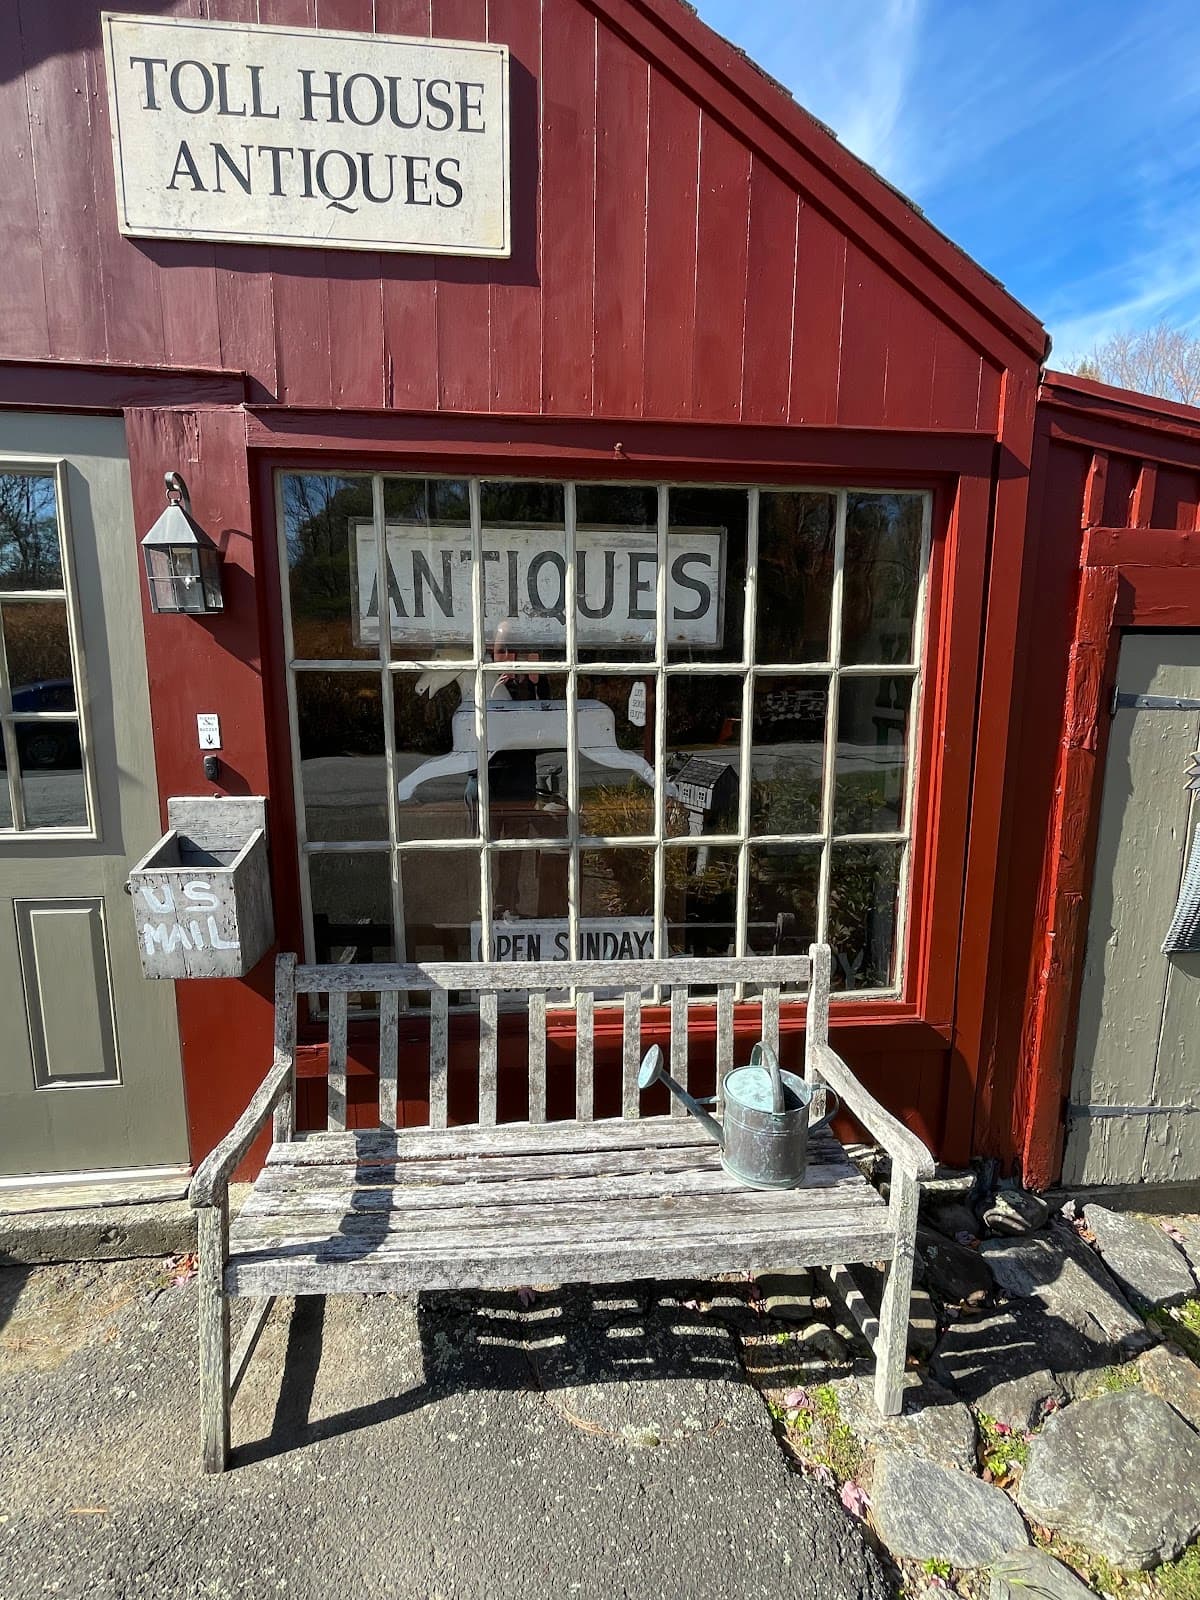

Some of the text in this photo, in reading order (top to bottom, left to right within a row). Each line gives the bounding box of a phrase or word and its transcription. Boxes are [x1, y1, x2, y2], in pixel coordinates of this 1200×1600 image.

[130, 56, 486, 133] TOLL HOUSE
[166, 140, 463, 213] ANTIQUES
[366, 550, 712, 626] ANTIQUES
[143, 916, 240, 955] MAIL
[478, 934, 541, 962] OPEN
